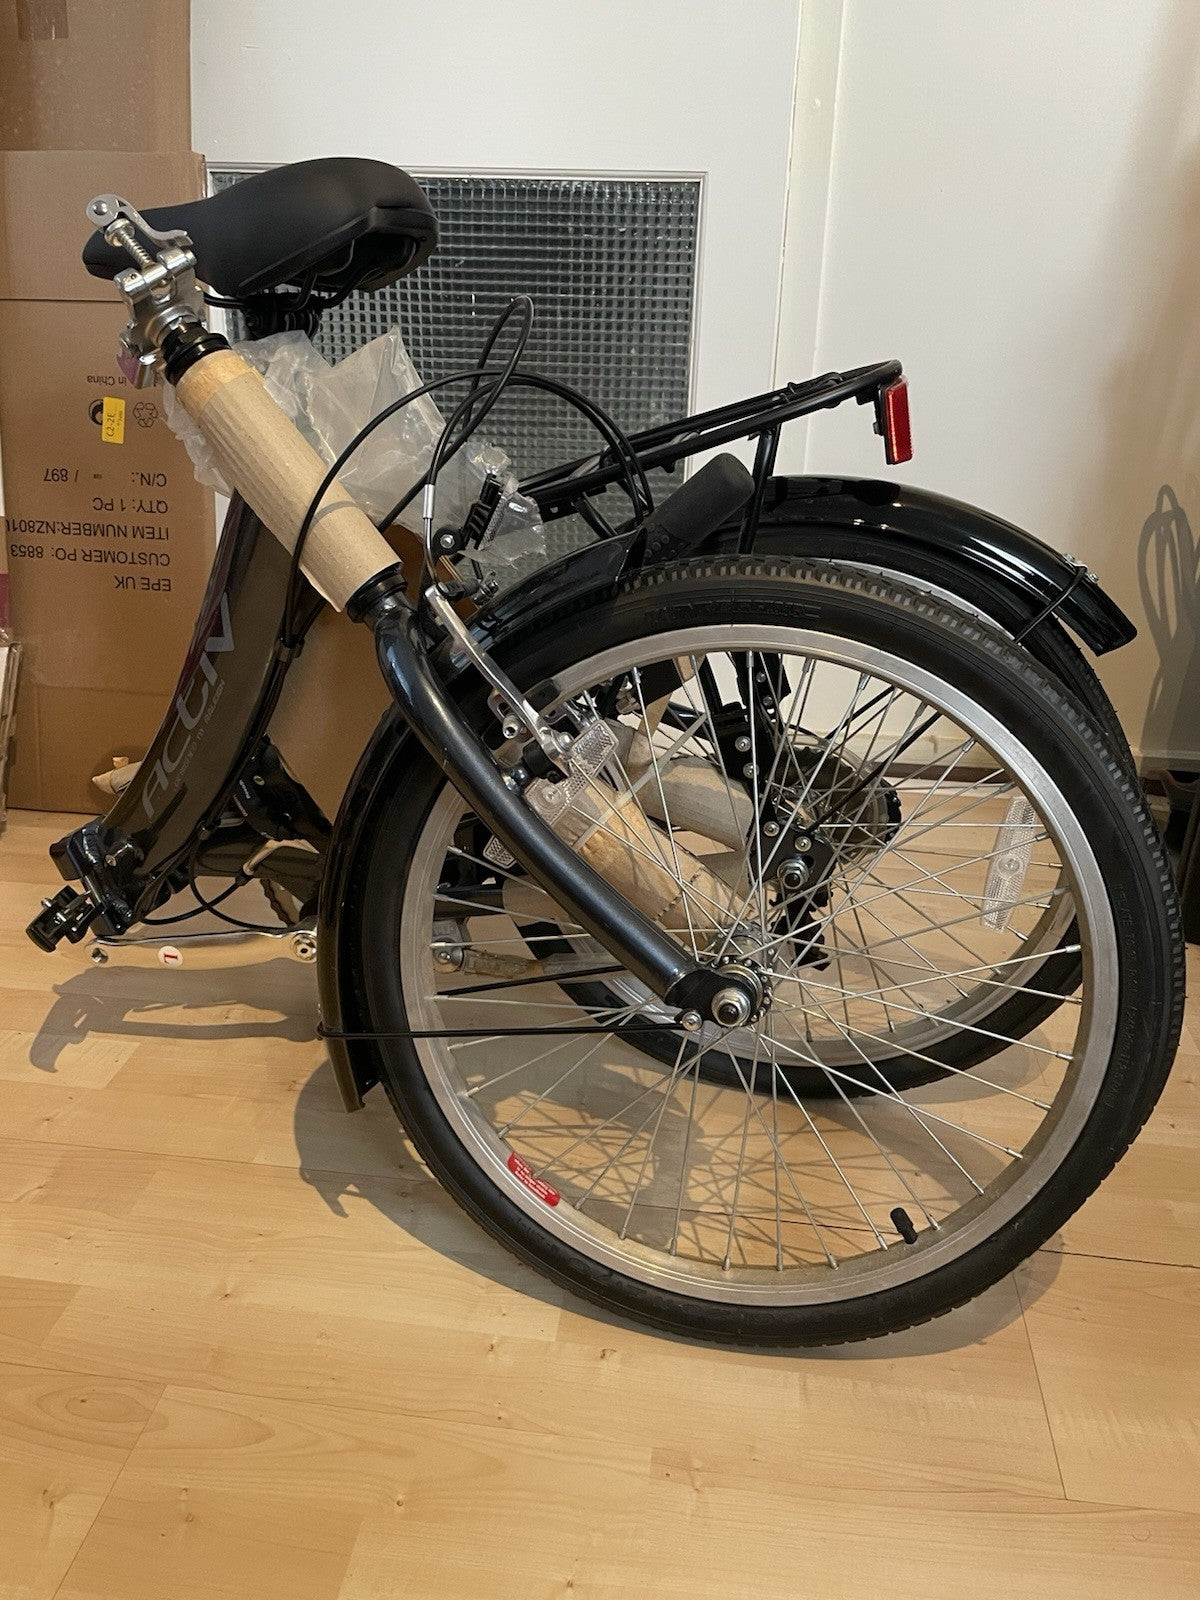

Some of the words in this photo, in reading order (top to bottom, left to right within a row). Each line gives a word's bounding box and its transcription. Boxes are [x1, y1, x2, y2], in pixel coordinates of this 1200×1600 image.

[86, 375, 116, 386] China
[43, 468, 69, 482] 897
[92, 497, 114, 511] PC
[120, 499, 126, 512] 1
[133, 499, 169, 514] QTY:
[132, 525, 169, 541] ITEM
[10, 543, 44, 559] 8853
[51, 547, 77, 562] PO:
[82, 549, 171, 567] CUSTOMER
[114, 575, 136, 590] UK
[140, 576, 172, 592] EPE
